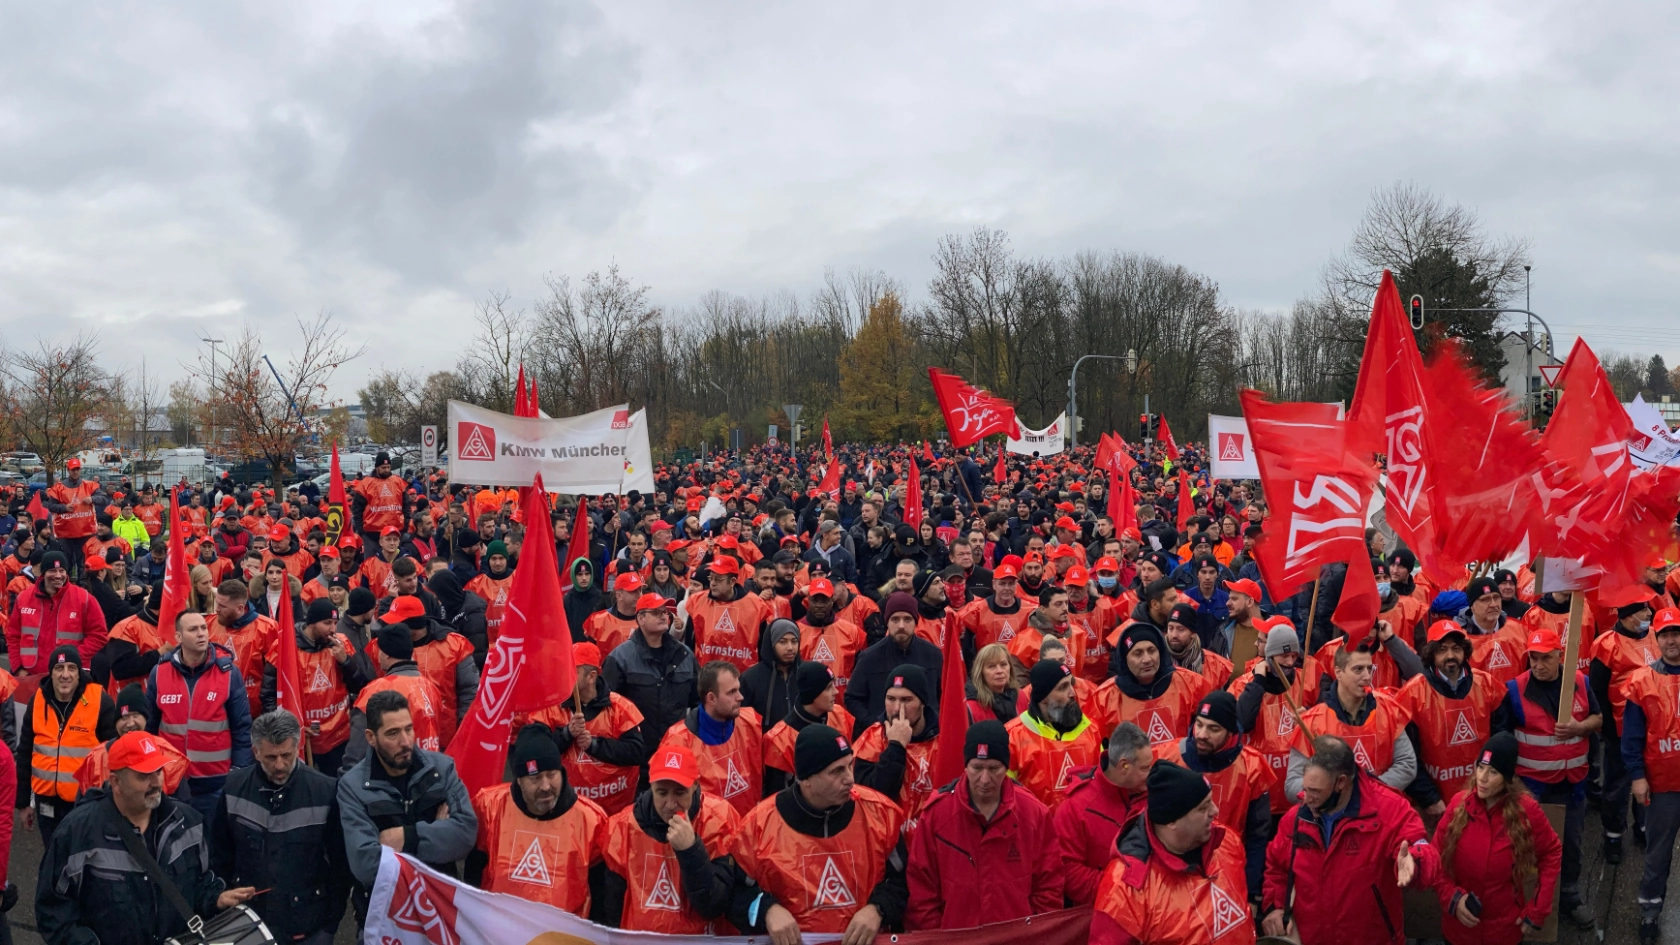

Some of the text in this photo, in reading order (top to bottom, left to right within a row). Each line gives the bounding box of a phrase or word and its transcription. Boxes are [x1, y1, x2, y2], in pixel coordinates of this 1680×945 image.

[1651, 424, 1660, 432] 8
[501, 442, 546, 458] KMW
[21, 607, 36, 616] GEBT
[160, 693, 183, 705] GEBT
[206, 691, 218, 703] 8!
